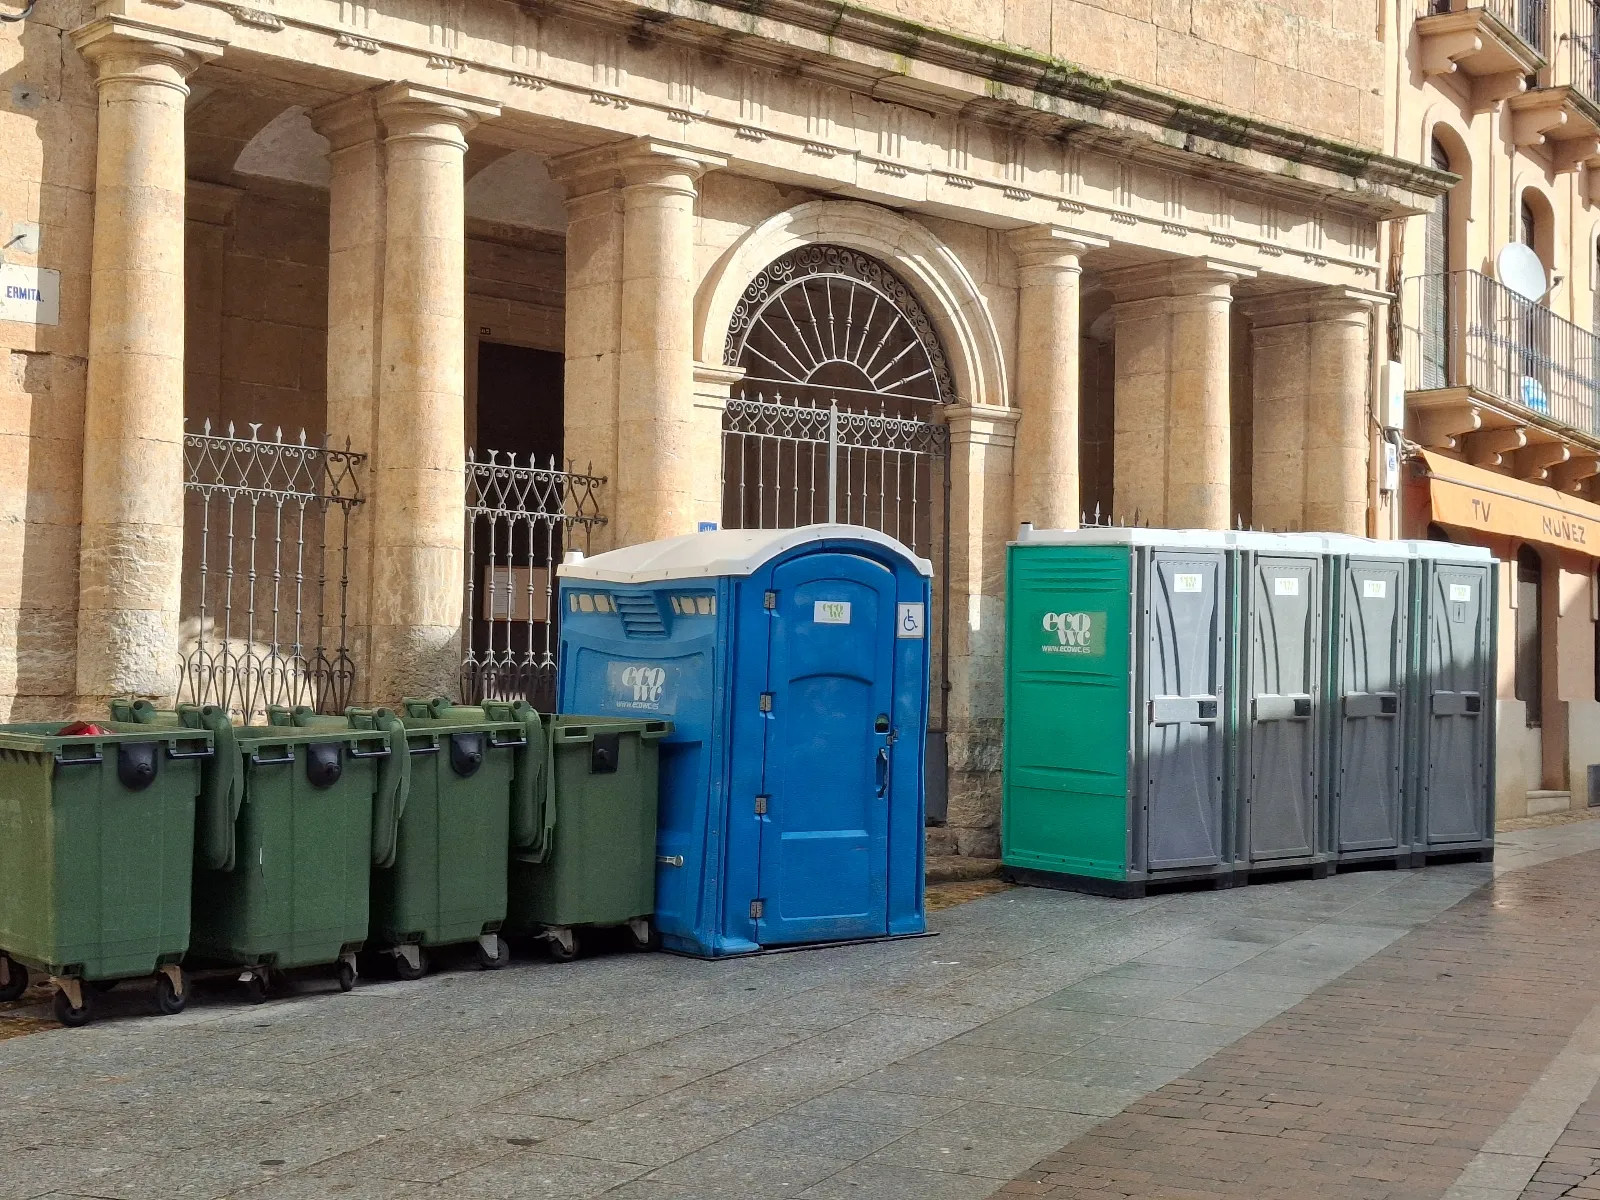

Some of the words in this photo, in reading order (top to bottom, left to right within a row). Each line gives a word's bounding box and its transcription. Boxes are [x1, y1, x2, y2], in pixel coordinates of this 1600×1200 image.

[1472, 499, 1491, 522] TV
[1043, 612, 1091, 631] eco
[1042, 645, 1091, 653] www.ecowc.es
[622, 666, 666, 686] eco
